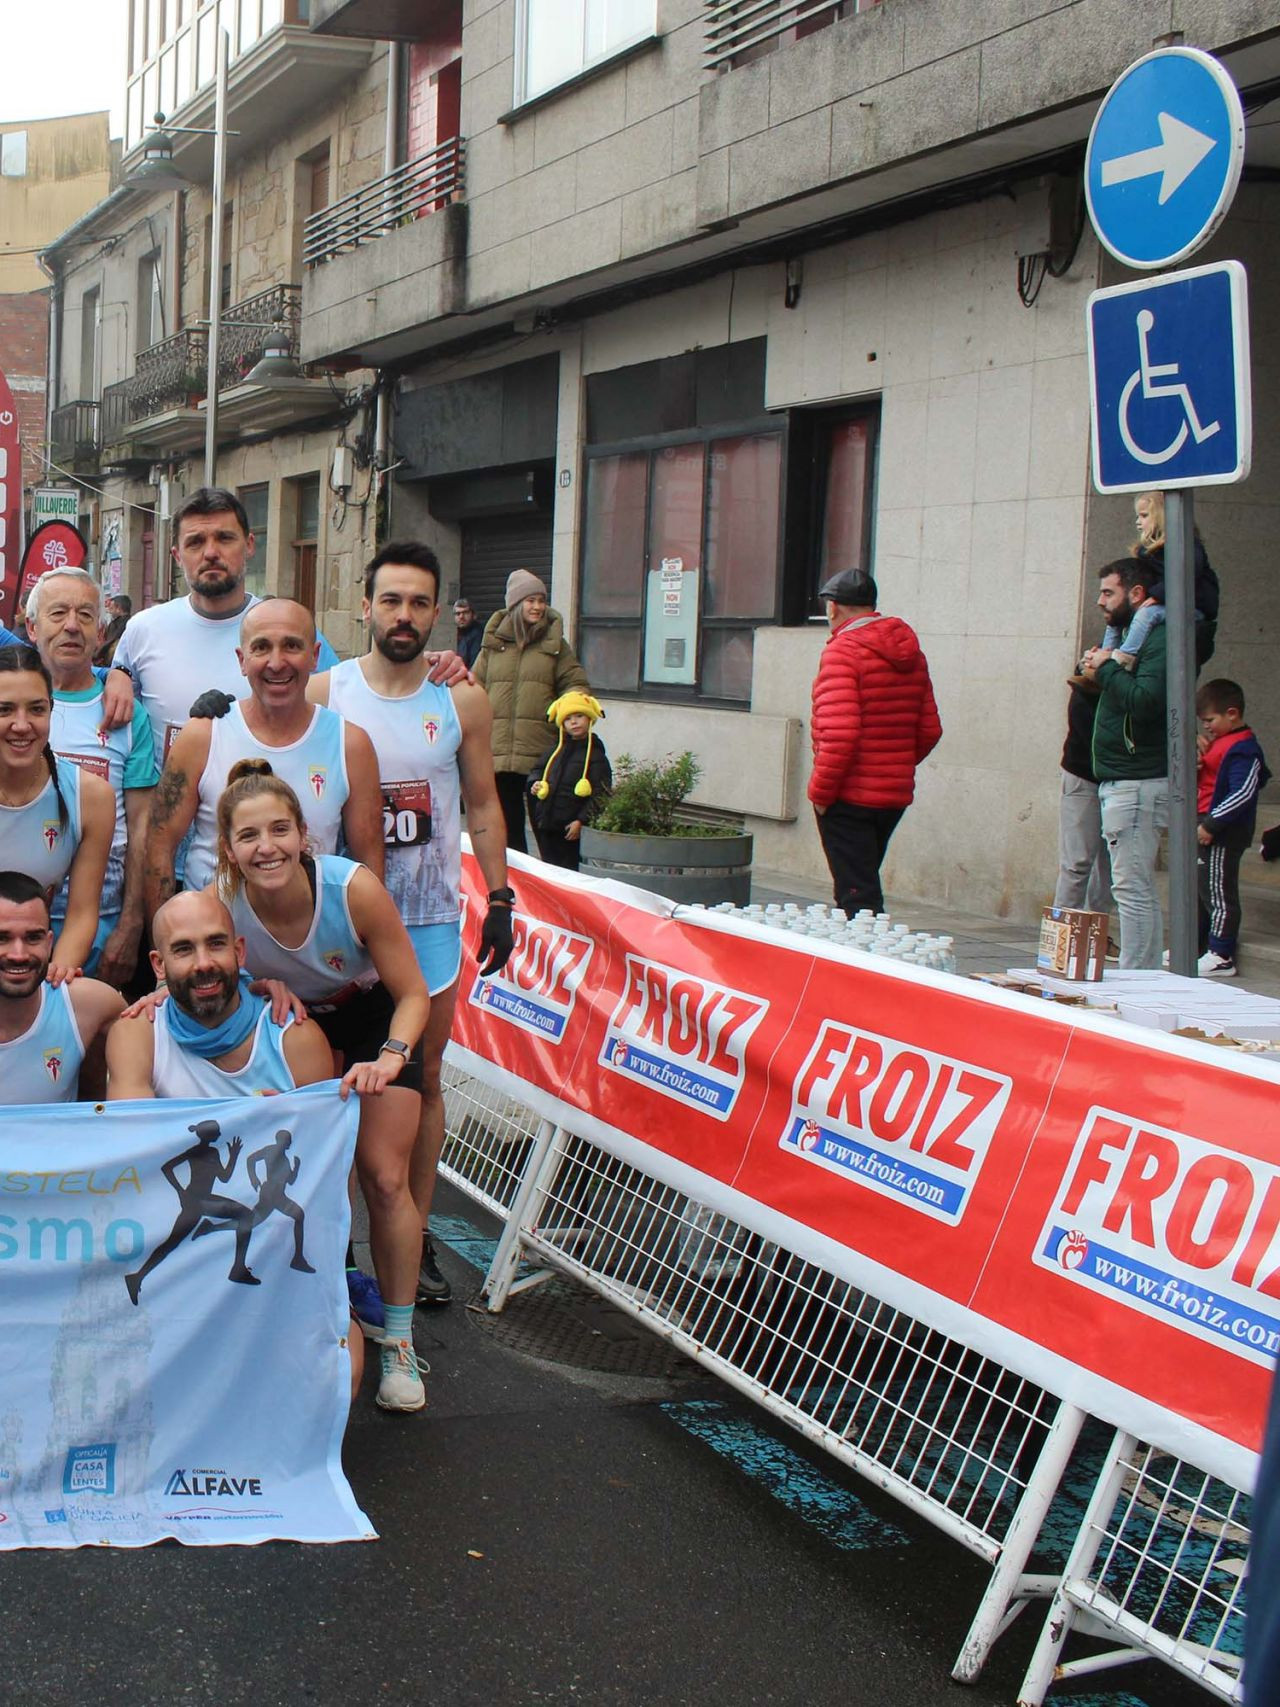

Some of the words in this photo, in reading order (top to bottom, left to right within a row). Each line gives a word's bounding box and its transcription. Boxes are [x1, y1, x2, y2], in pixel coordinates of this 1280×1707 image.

[34, 495, 78, 515] VILLAVERDE
[498, 918, 593, 1006] ROIZ
[491, 990, 556, 1032] www.froiz.com
[614, 959, 763, 1077] FROIZ
[629, 1054, 721, 1106] www.froiz.com
[797, 1026, 1005, 1172] FROIZ
[822, 1138, 945, 1206] www.froiz.com
[1059, 1115, 1280, 1300] FROI
[73, 1479, 104, 1487] LENTES
[75, 1462, 104, 1472] CASA
